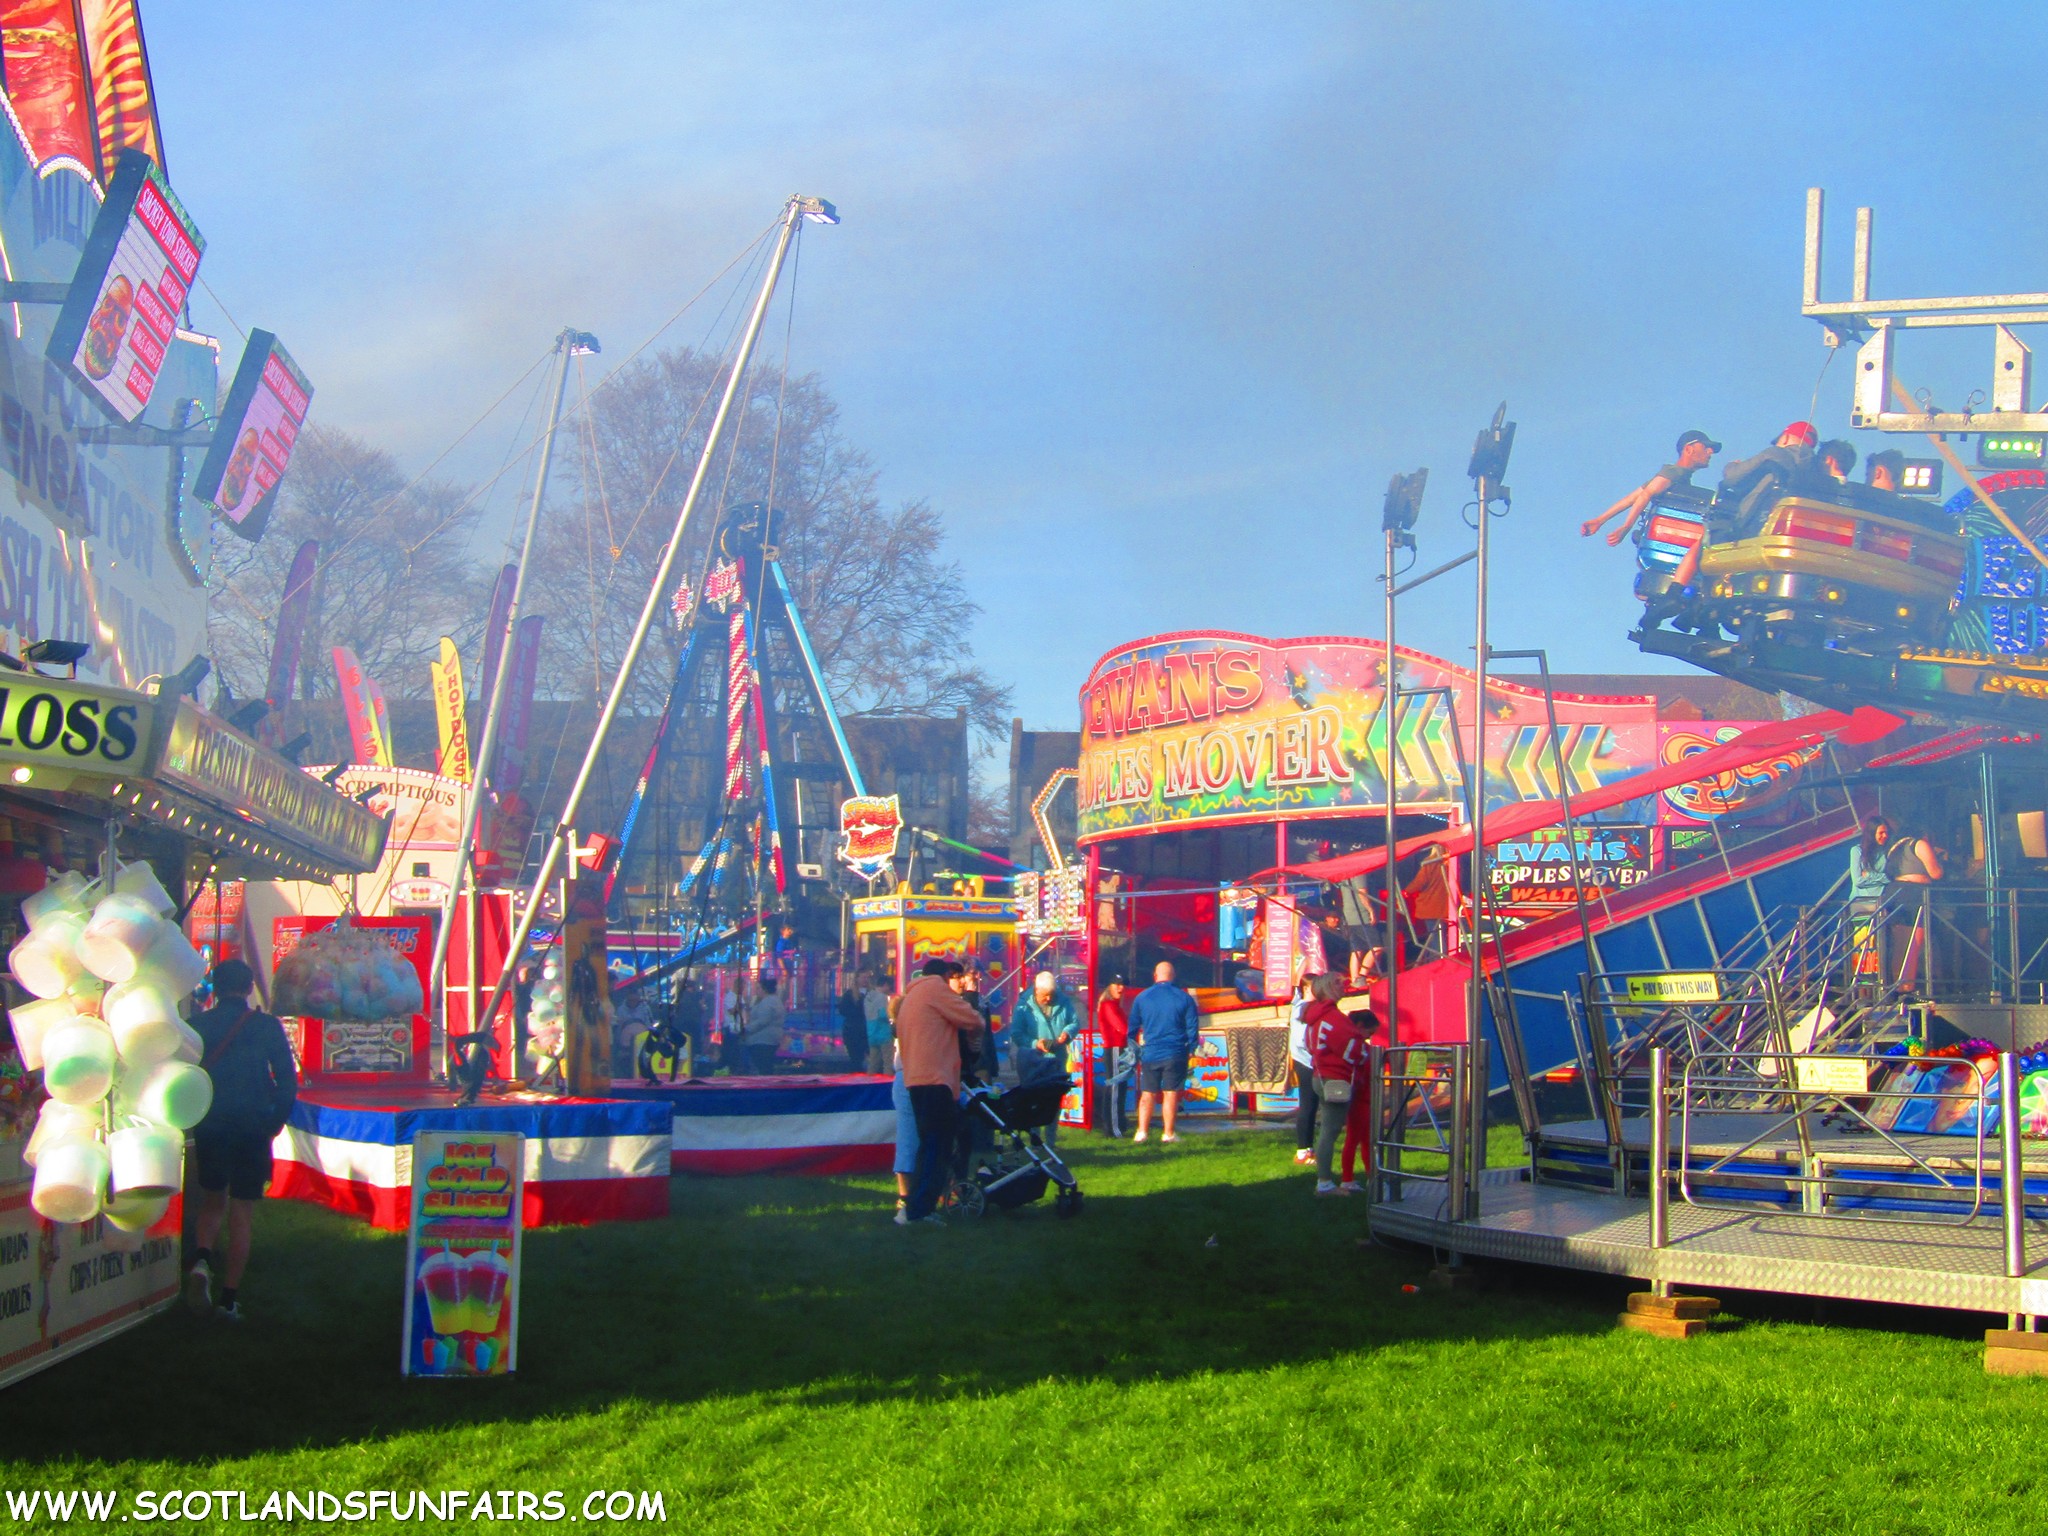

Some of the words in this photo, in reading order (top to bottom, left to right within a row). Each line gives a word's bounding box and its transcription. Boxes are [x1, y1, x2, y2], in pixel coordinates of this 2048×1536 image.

[139, 188, 166, 231] SMOKEY
[159, 215, 180, 251] TOWN
[1089, 650, 1264, 735] EVANS
[1163, 705, 1355, 798] MOVER
[1532, 829, 1591, 842] IT'S
[1497, 841, 1628, 862] EVANS
[1489, 866, 1571, 885] EOPLES
[1642, 982, 1656, 996] PAY
[1658, 982, 1673, 995] BOX
[1674, 981, 1694, 995] THIS
[1696, 980, 1713, 994] WAY
[444, 1142, 496, 1168] ICE
[427, 1165, 510, 1192] COLD
[422, 1190, 513, 1218] SLUSH
